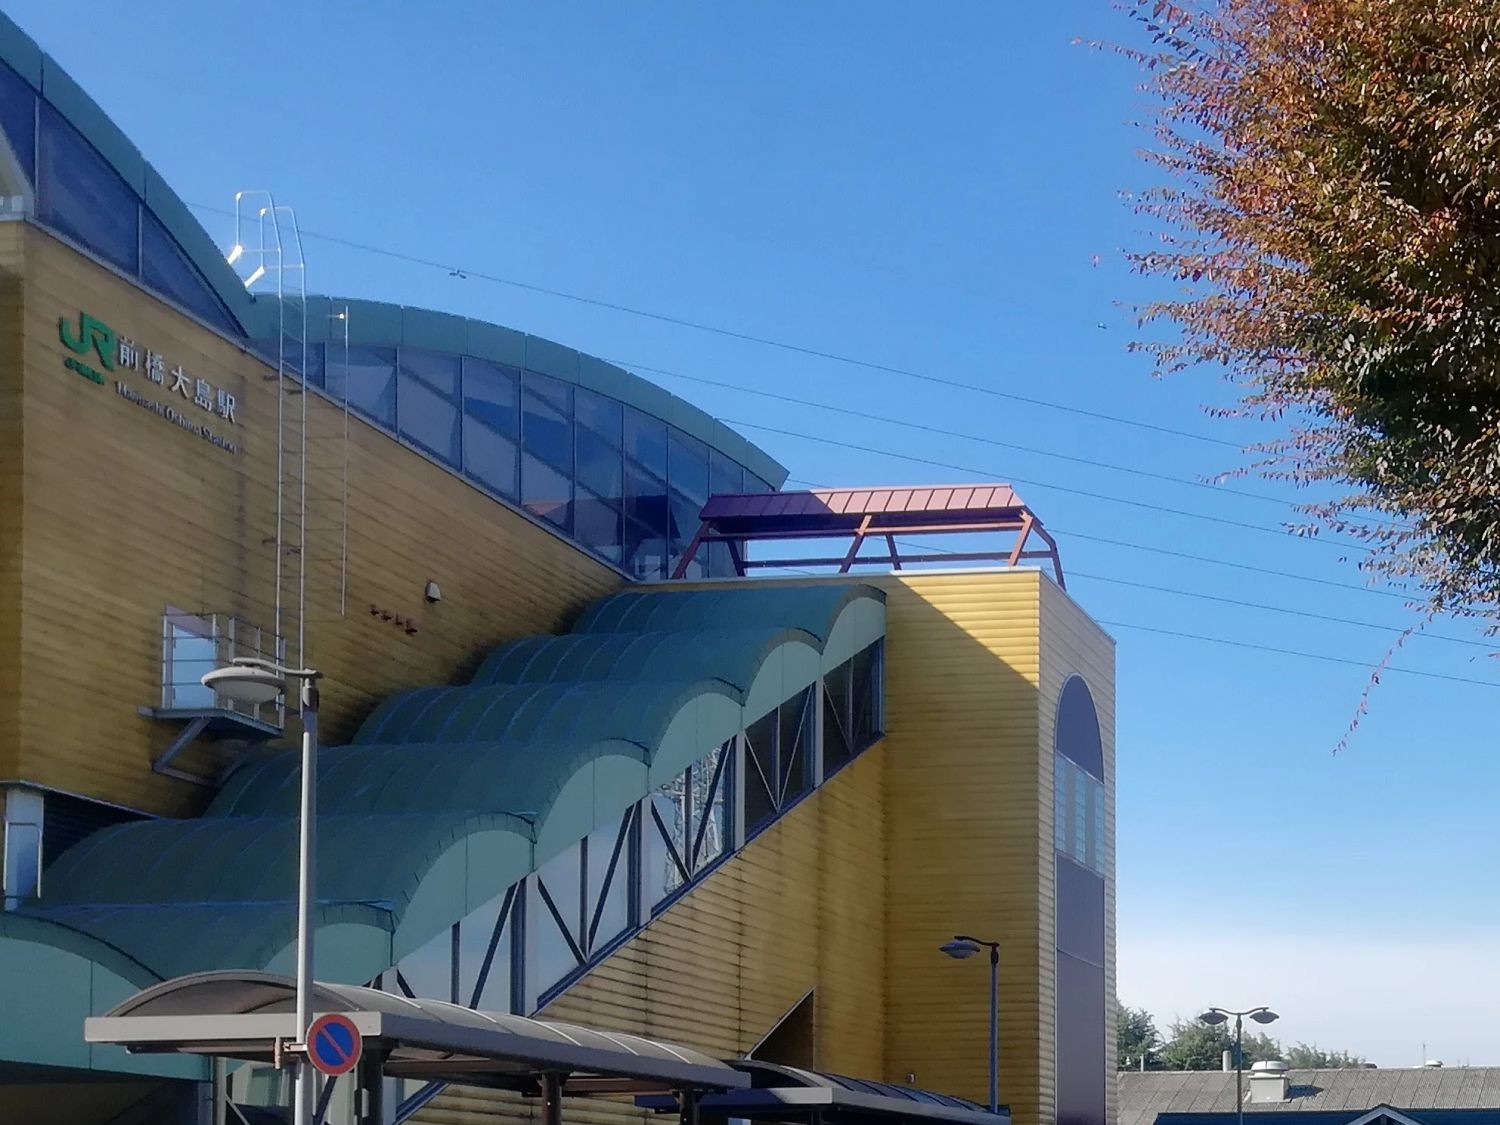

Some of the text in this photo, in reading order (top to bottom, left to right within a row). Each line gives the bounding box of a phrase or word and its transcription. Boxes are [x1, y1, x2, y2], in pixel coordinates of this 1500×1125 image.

[59, 312, 115, 372] JR
[118, 336, 236, 423] 前橋大島駅
